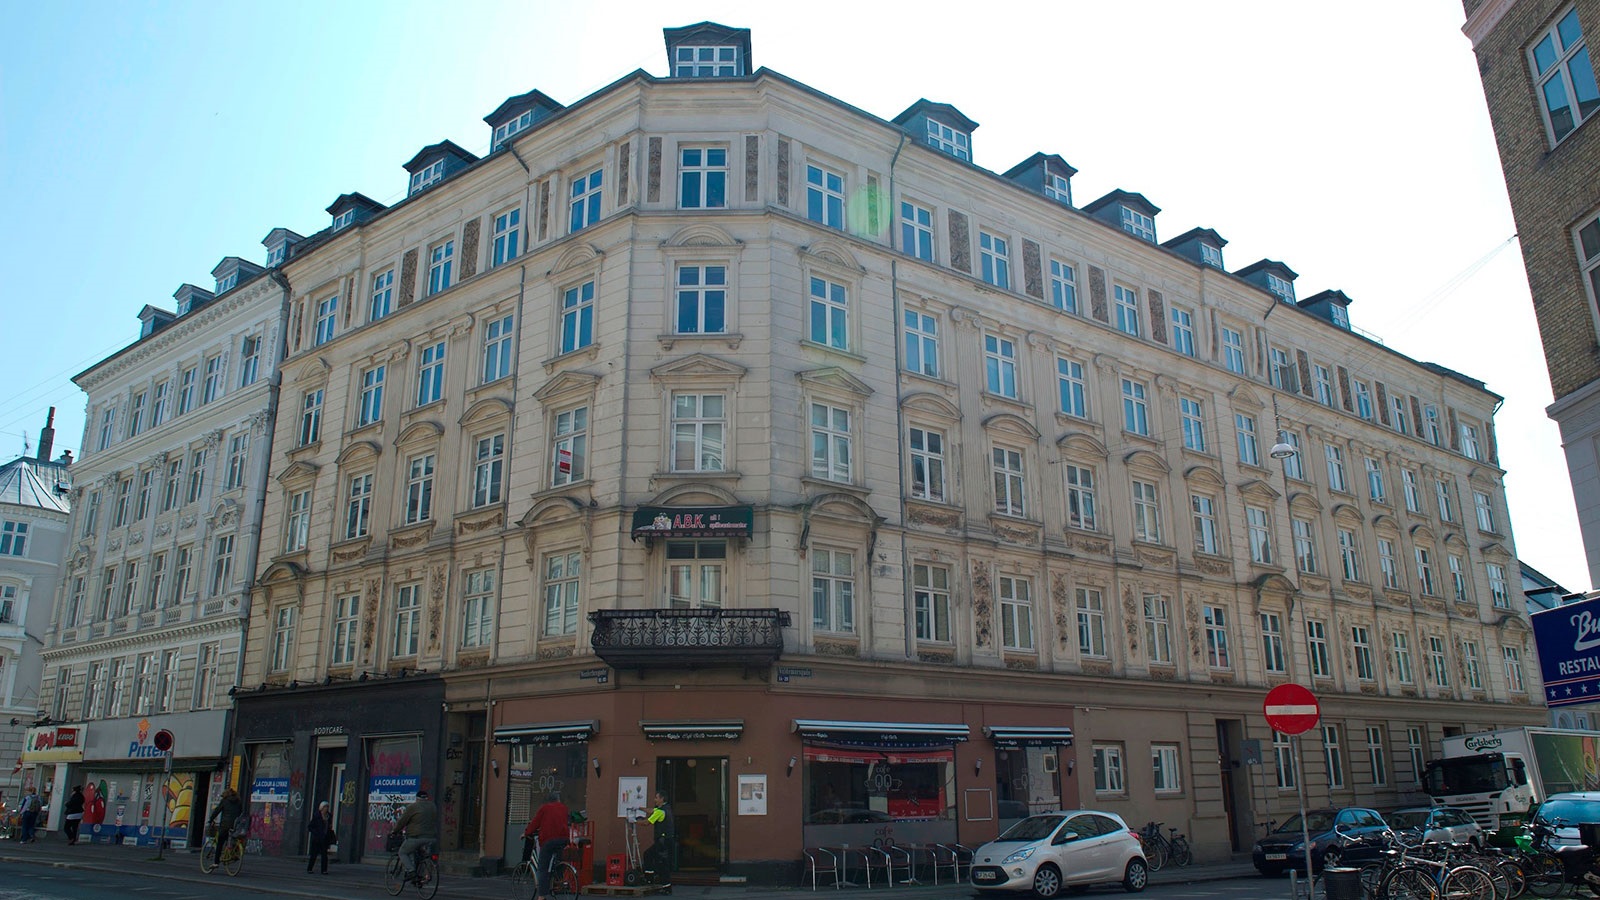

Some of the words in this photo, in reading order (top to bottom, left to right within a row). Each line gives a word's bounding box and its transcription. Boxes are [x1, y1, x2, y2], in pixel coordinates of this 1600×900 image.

[672, 513, 706, 529] A.B.K.
[313, 725, 344, 735] BODYCARE
[57, 732, 75, 741] LEGO
[1464, 734, 1502, 752] Carlsberg
[382, 778, 396, 786] COUR
